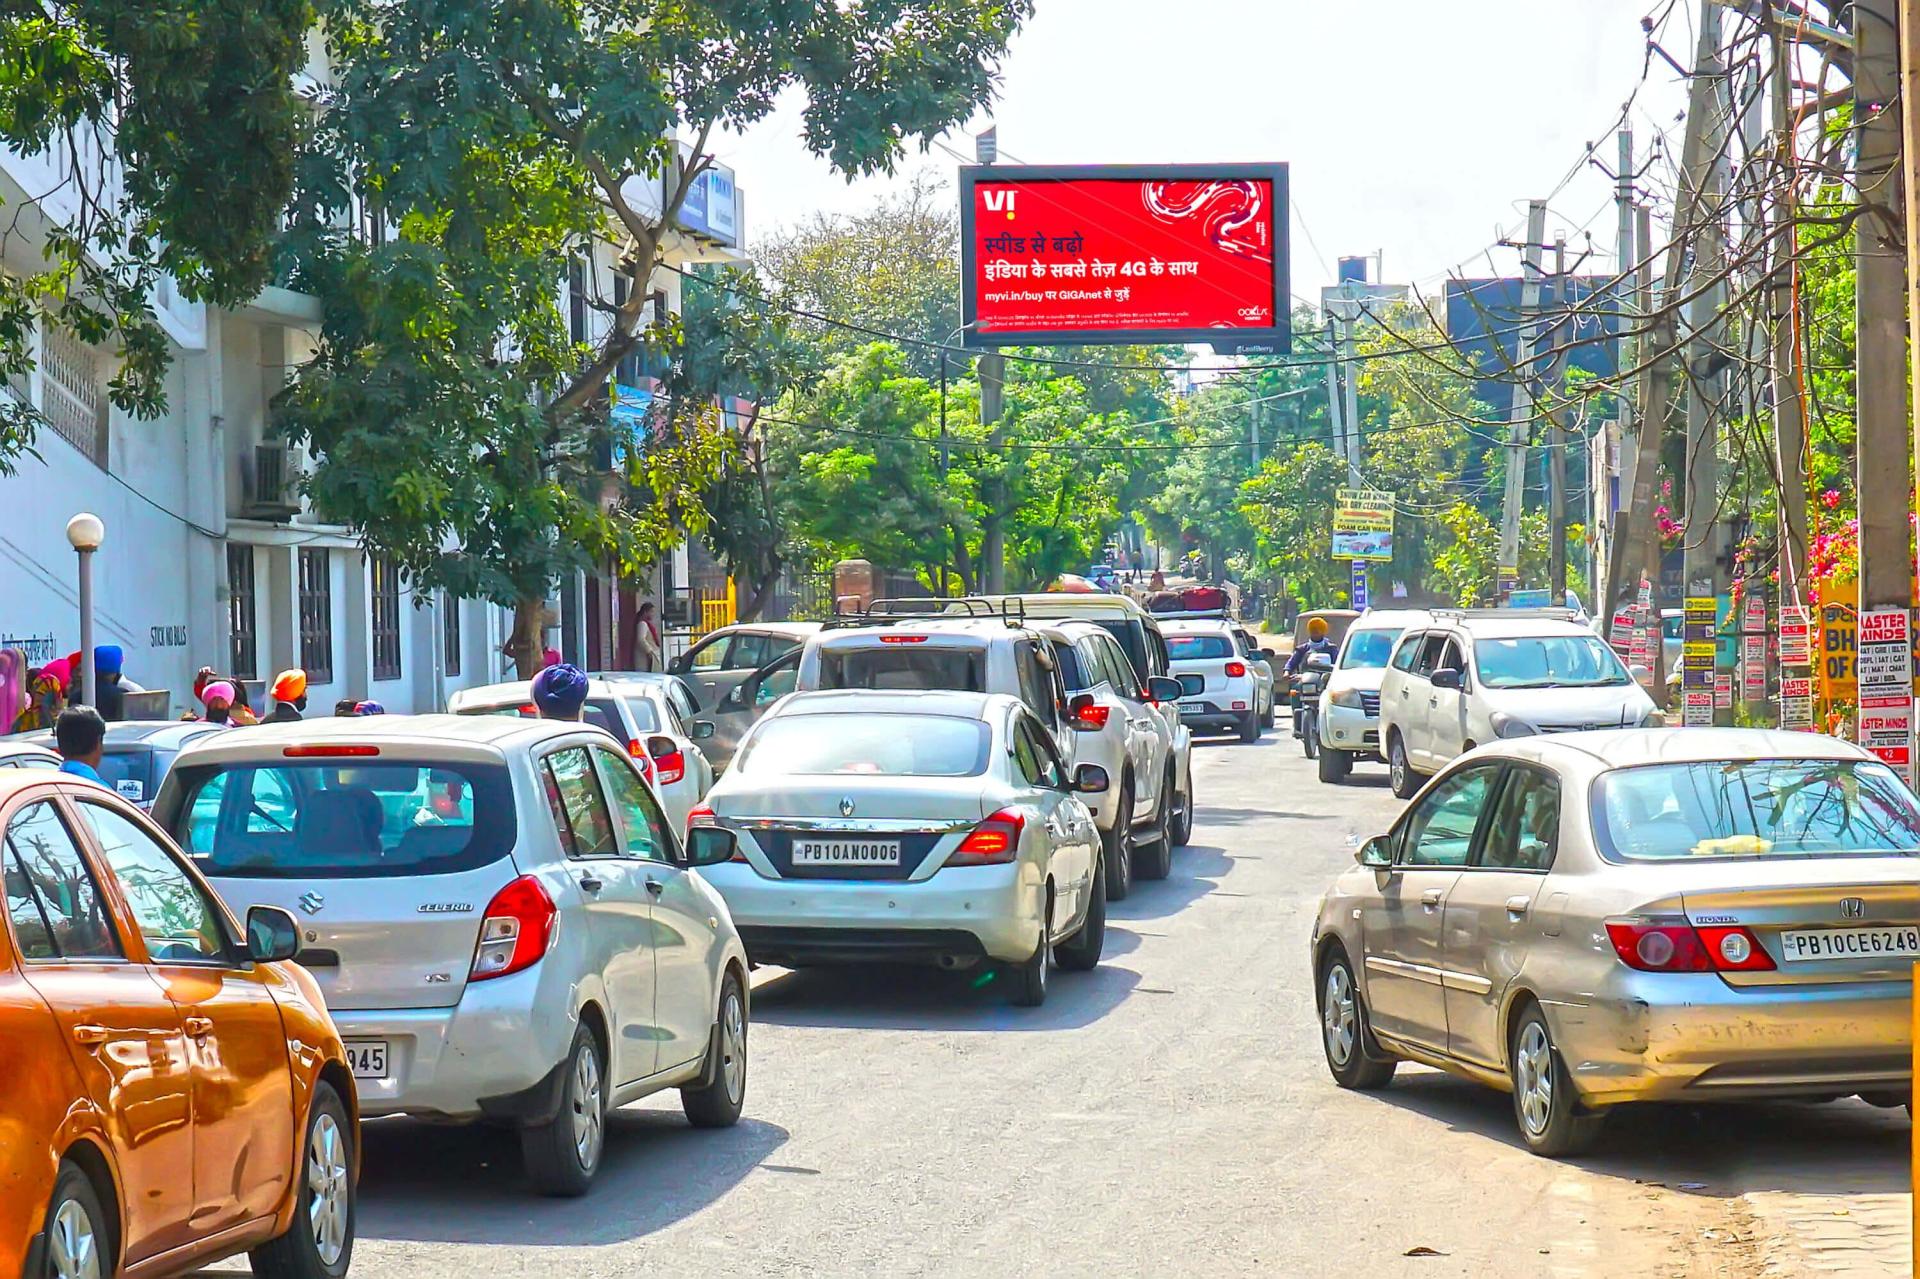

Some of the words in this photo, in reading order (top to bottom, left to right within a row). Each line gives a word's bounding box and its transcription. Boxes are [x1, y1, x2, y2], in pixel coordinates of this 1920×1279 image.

[984, 232, 1026, 254] स्पीड
[1030, 231, 1047, 253] से
[1051, 231, 1084, 257] बढ़ो
[984, 258, 1028, 281] इंडिया
[1031, 258, 1047, 278] के
[1050, 258, 1087, 278] सबसे
[1091, 258, 1117, 278] तेज़
[1120, 261, 1147, 277] 4G
[1149, 257, 1165, 276] के
[1168, 261, 1199, 276] साथ
[985, 291, 1043, 302] myvi.in/buy
[1045, 290, 1057, 300] पर
[1059, 290, 1102, 300] GIGAnet
[1103, 287, 1113, 299] से
[150, 626, 165, 648] STICK
[166, 626, 173, 647] NO
[174, 625, 187, 646] BILLS
[1826, 628, 1857, 652] BH
[1827, 656, 1849, 679] OF
[804, 844, 898, 861] PB10AN0006
[417, 902, 475, 913] CELERIO
[1696, 916, 1739, 924] HONDA
[1796, 931, 1919, 956] PB10CE6248
